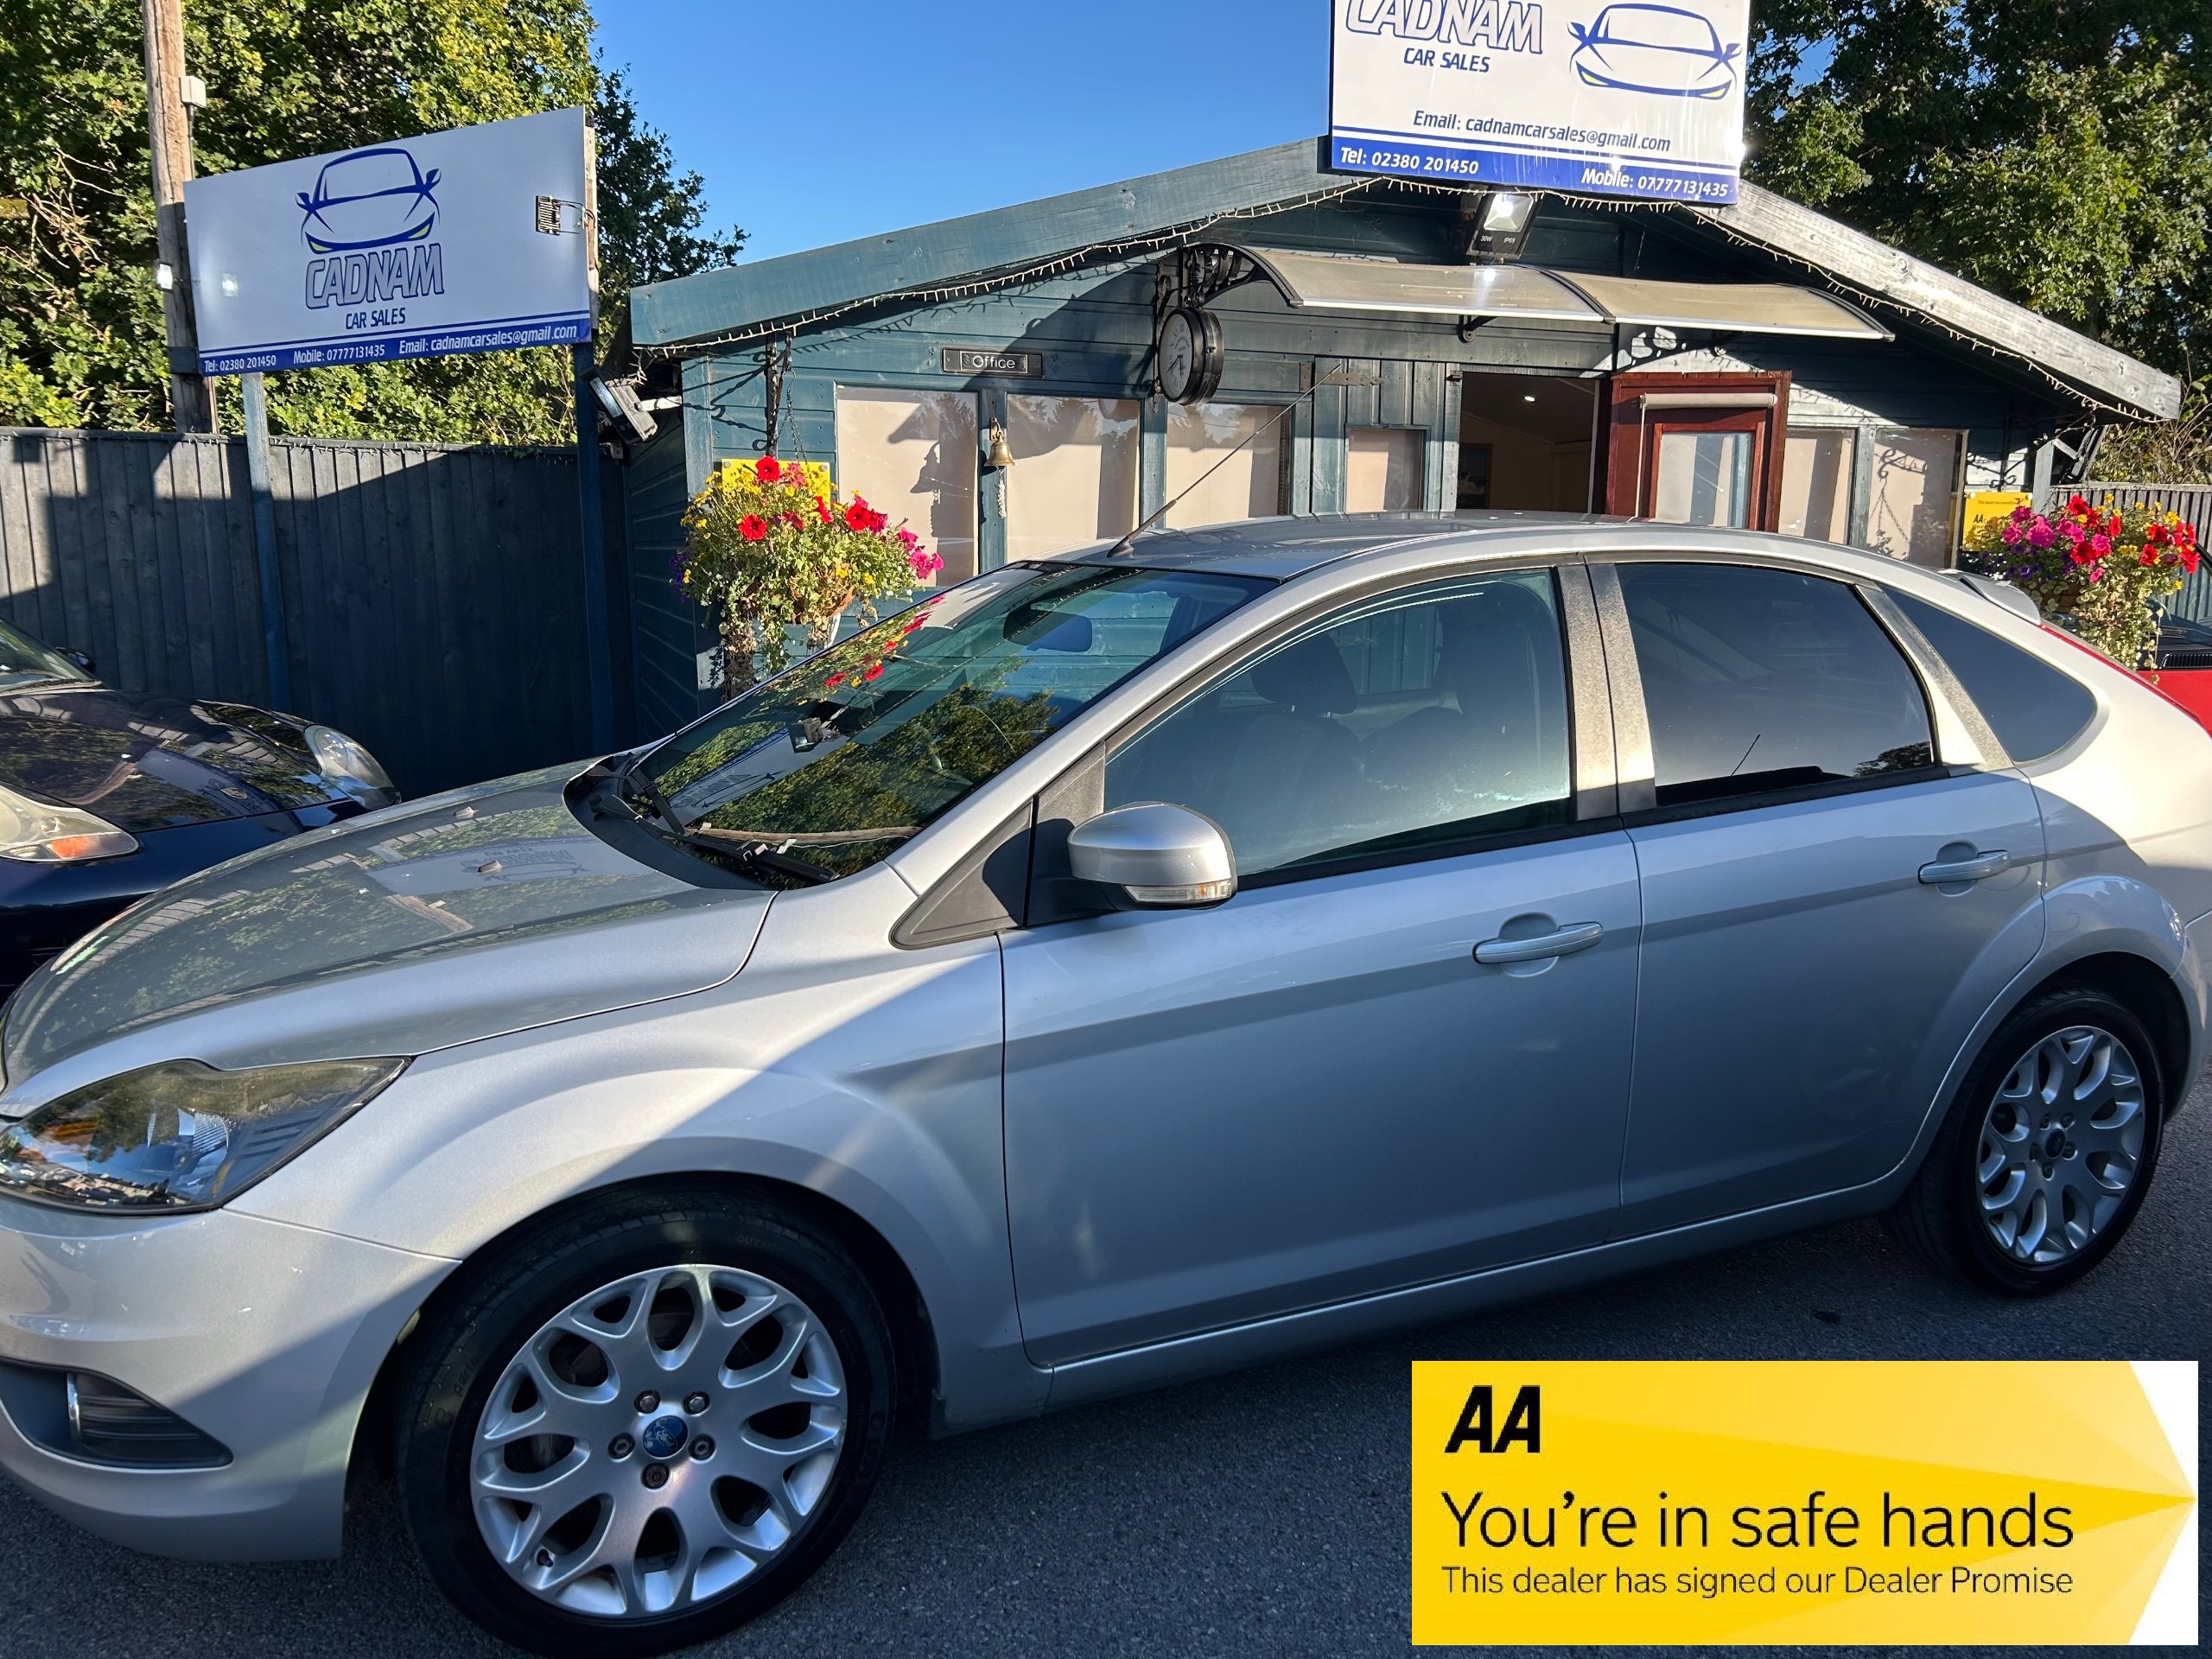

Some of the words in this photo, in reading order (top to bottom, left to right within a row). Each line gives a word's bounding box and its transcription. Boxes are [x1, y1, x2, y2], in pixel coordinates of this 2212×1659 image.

[1345, 0, 1543, 54] CADNAM
[1403, 47, 1436, 67] CAR
[1440, 52, 1491, 73] SALES
[1413, 110, 1461, 130] Email:
[1465, 118, 1671, 152] cadnamcarsales@gmail.com
[1340, 147, 1368, 165] Tel:
[1371, 151, 1421, 169] 02380
[1423, 156, 1479, 175] 201450
[1580, 168, 1635, 189] Mobile:
[1637, 175, 1729, 198] 07777131435
[305, 243, 445, 309] CADNAM
[346, 312, 367, 329] CAR
[371, 308, 406, 327] SALES
[398, 338, 429, 354] Email:
[430, 325, 578, 351] cadnamcarsales@gmail.com
[204, 359, 219, 372] Tel:
[219, 358, 245, 372] 02380
[246, 354, 276, 369] 201450
[293, 349, 326, 364] Mobile:
[327, 344, 385, 360] 07777131435
[972, 355, 1016, 369] Office
[1973, 514, 1984, 524] AA
